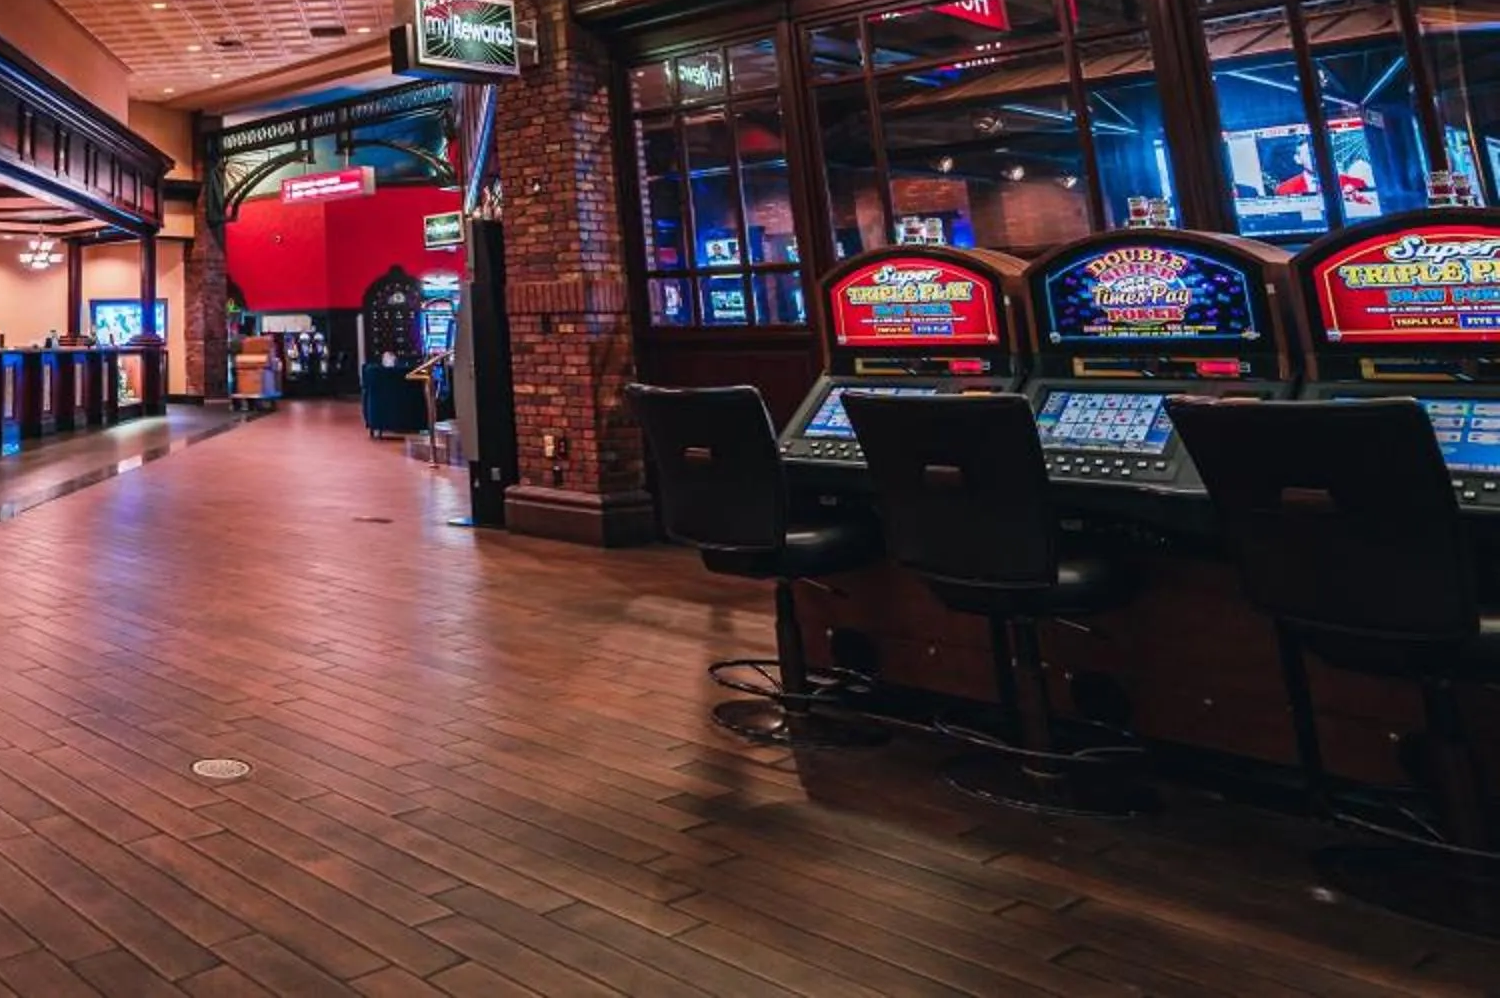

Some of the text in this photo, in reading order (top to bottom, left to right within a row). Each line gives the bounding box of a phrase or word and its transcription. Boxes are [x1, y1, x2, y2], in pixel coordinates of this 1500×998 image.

[453, 14, 513, 47] Rewards
[1384, 235, 1500, 263] Super
[874, 266, 943, 286] Super
[1085, 248, 1189, 278] DOUBLE
[1339, 261, 1467, 287] TRIPLE
[847, 284, 918, 304] TRIPLE
[1092, 283, 1190, 309] Times Pay
[1107, 307, 1185, 322] POKER
